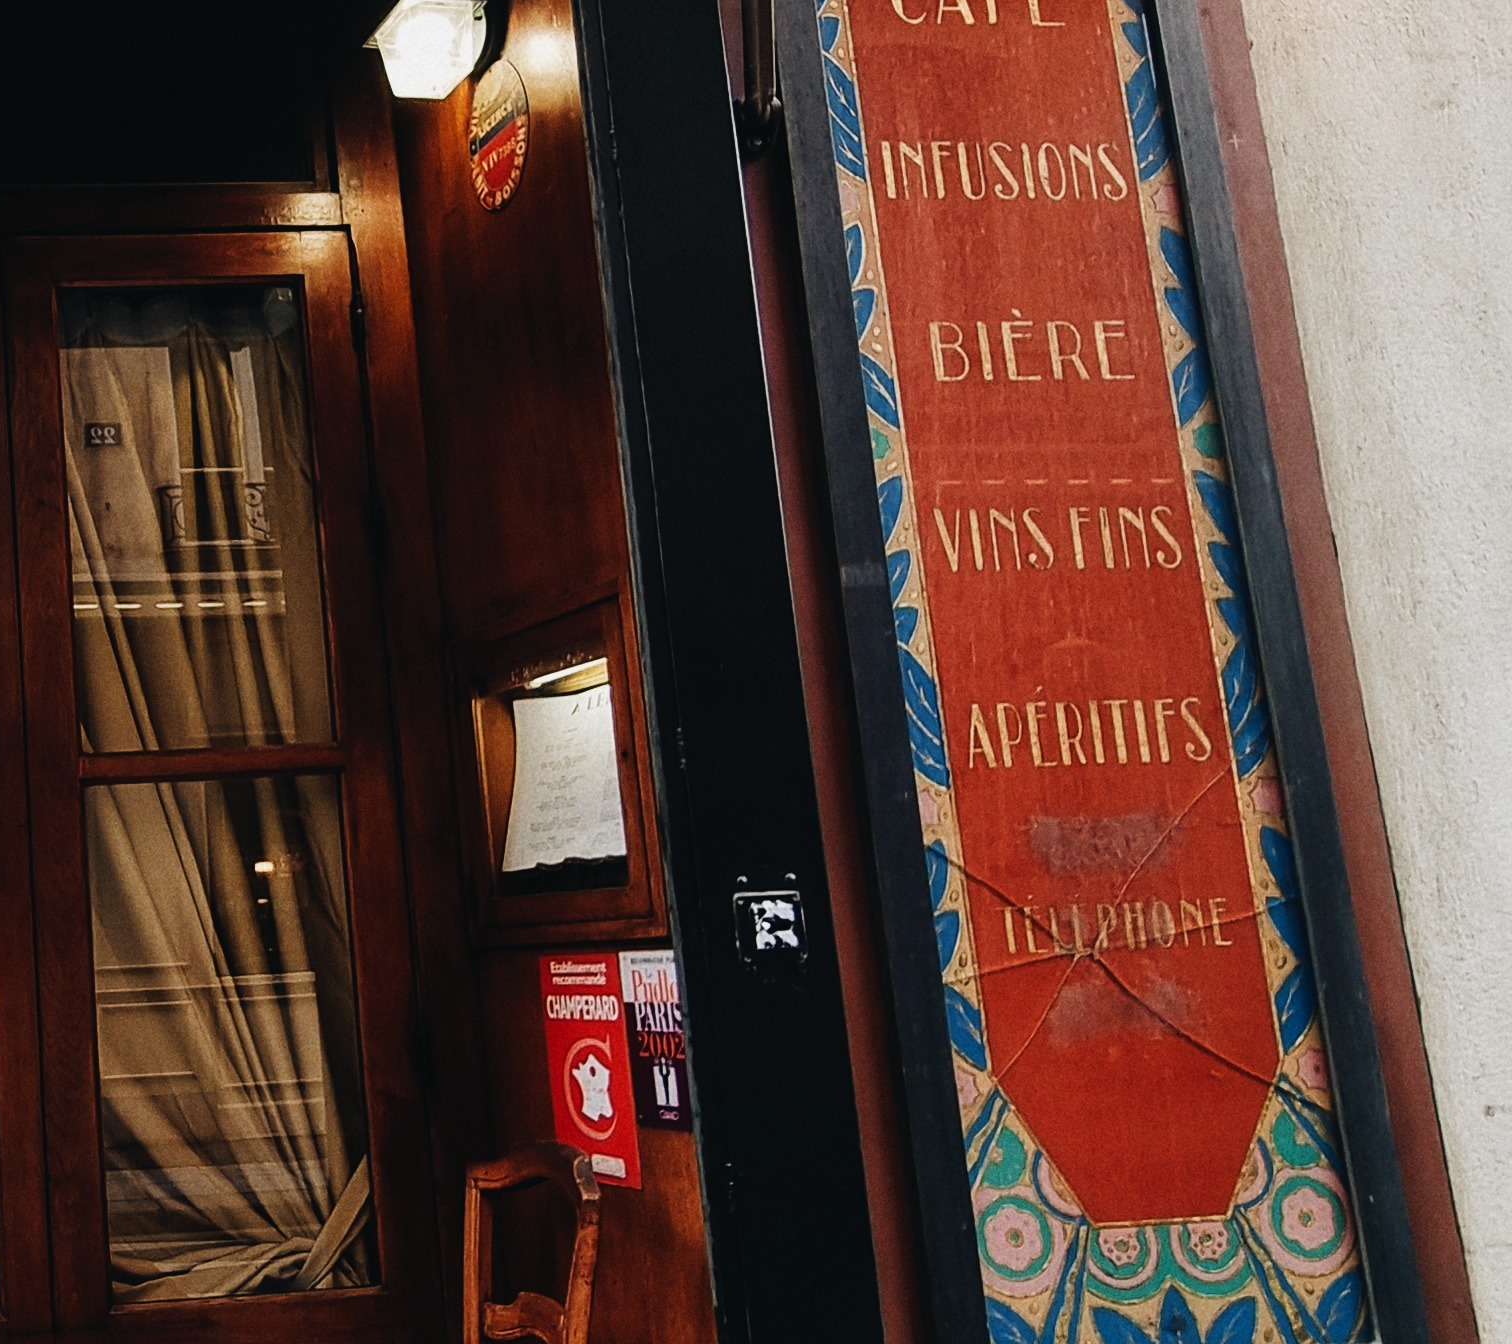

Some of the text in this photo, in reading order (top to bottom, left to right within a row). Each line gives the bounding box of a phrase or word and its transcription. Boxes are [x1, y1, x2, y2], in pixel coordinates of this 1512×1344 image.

[881, 140, 1129, 201] INFUSIONS
[928, 308, 1136, 382] BIÈRE
[932, 505, 1183, 573] VINS FINS
[967, 684, 1213, 769] APÉRITIFS
[546, 994, 619, 1022] CHAMPERARD
[634, 1001, 683, 1033] PARIS
[638, 1031, 686, 1060] 2002
